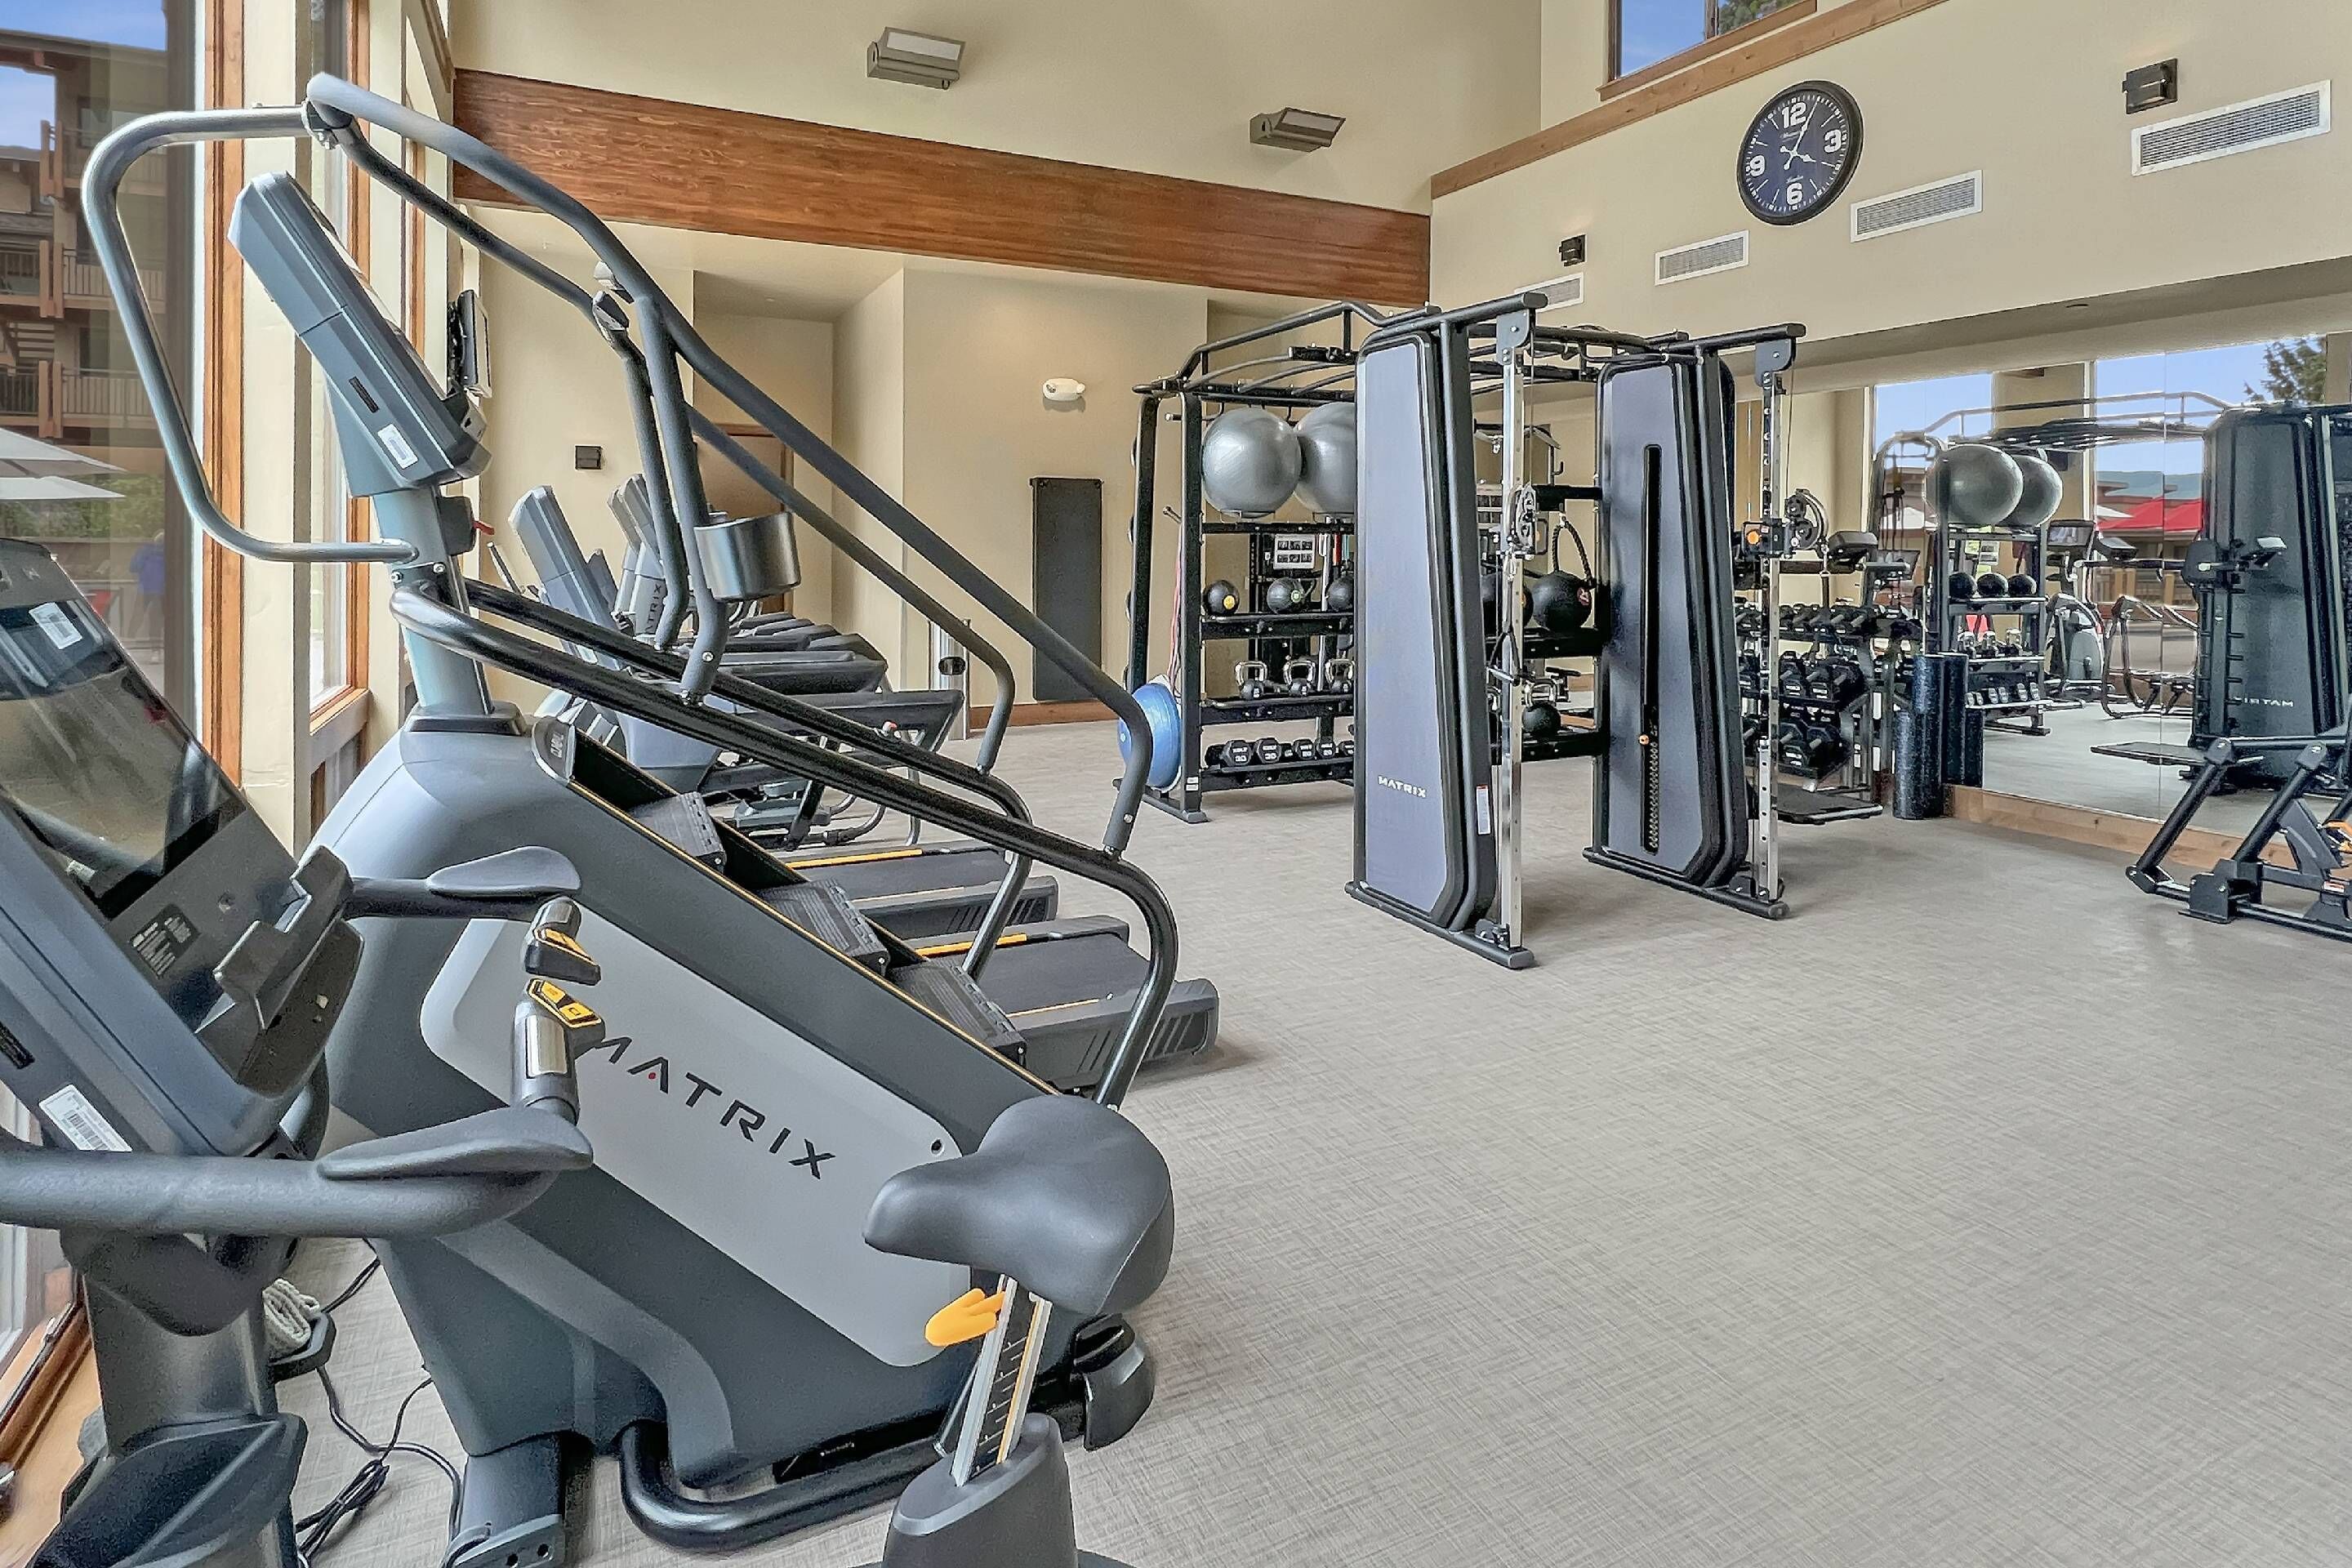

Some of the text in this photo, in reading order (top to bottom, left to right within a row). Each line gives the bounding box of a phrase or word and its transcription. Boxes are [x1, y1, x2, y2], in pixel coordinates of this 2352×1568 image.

[1781, 102, 1807, 129] 12
[1824, 129, 1842, 154] 3
[1749, 154, 1766, 177] 9
[1786, 182, 1803, 205] 6
[1378, 775, 1426, 798] MATRIX
